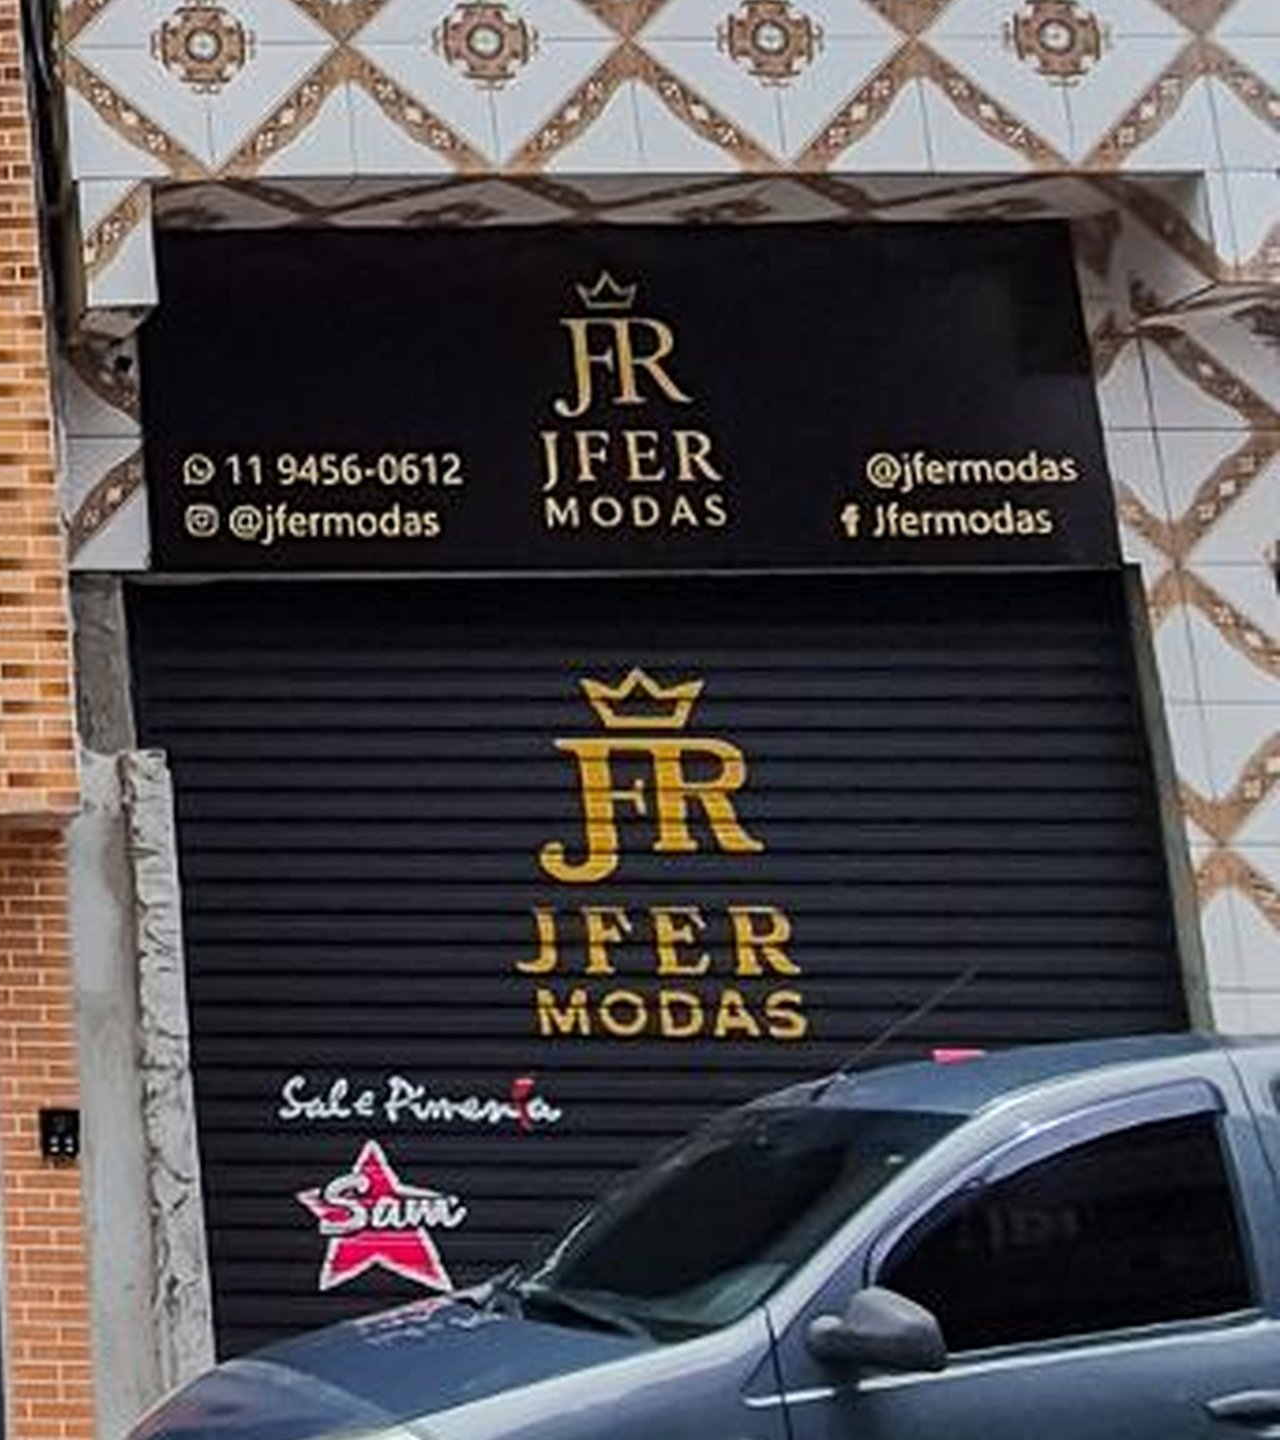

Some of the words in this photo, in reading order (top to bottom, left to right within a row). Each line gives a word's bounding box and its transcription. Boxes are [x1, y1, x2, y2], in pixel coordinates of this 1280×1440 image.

[224, 453, 263, 485] 11
[276, 452, 464, 486] 9456-0612
[540, 429, 724, 492] JFER
[865, 450, 1079, 493] @jfermodas
[228, 501, 441, 546] @jfermodas
[544, 493, 728, 528] MODAS
[515, 905, 802, 975] JFER
[536, 988, 808, 1038] MODAS
[278, 1075, 351, 1119] Sal
[352, 1090, 376, 1116] e
